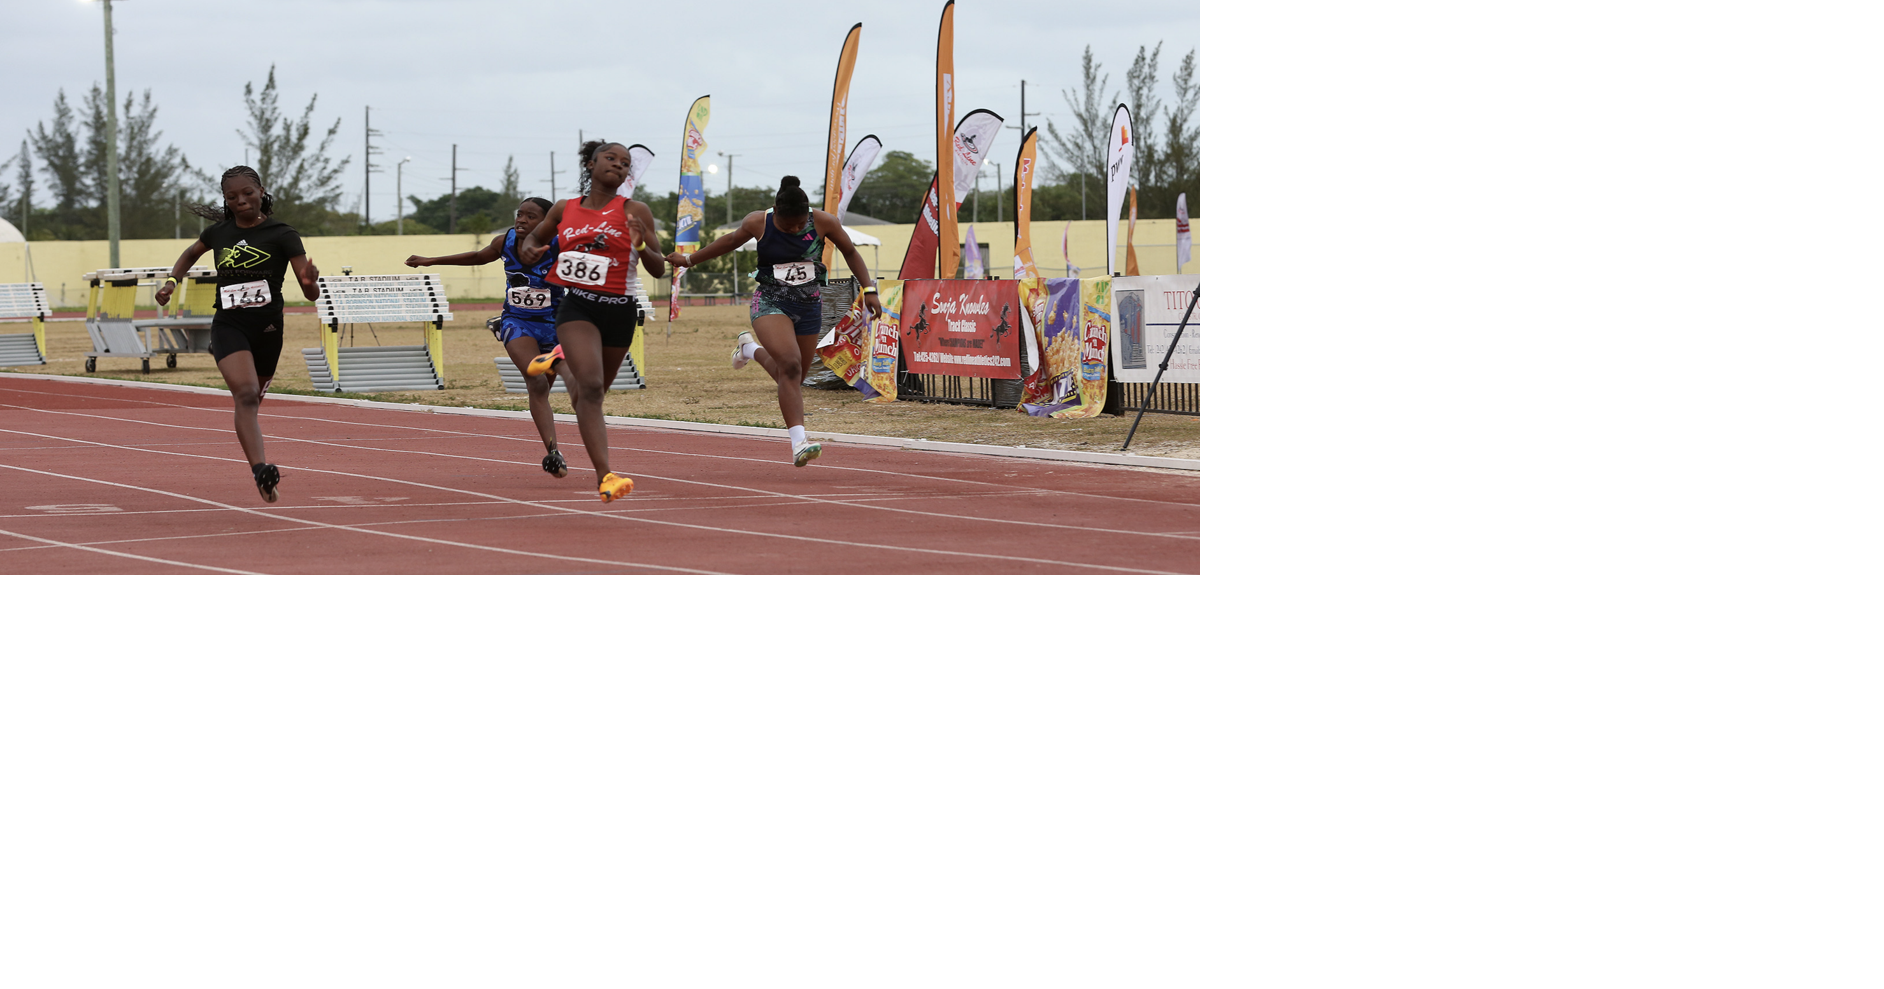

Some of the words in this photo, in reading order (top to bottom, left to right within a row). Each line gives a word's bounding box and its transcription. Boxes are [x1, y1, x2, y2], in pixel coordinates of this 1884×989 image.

[563, 221, 623, 241] Red-Line
[561, 259, 601, 281] 386
[785, 266, 807, 282] 45
[228, 289, 266, 307] 166
[512, 291, 546, 306] 569
[571, 287, 598, 301] NIKE
[598, 296, 628, 304] PRO
[931, 292, 957, 321] Sonja
[959, 293, 990, 316] Knowles
[948, 319, 960, 332] Track
[960, 319, 977, 333] Classic
